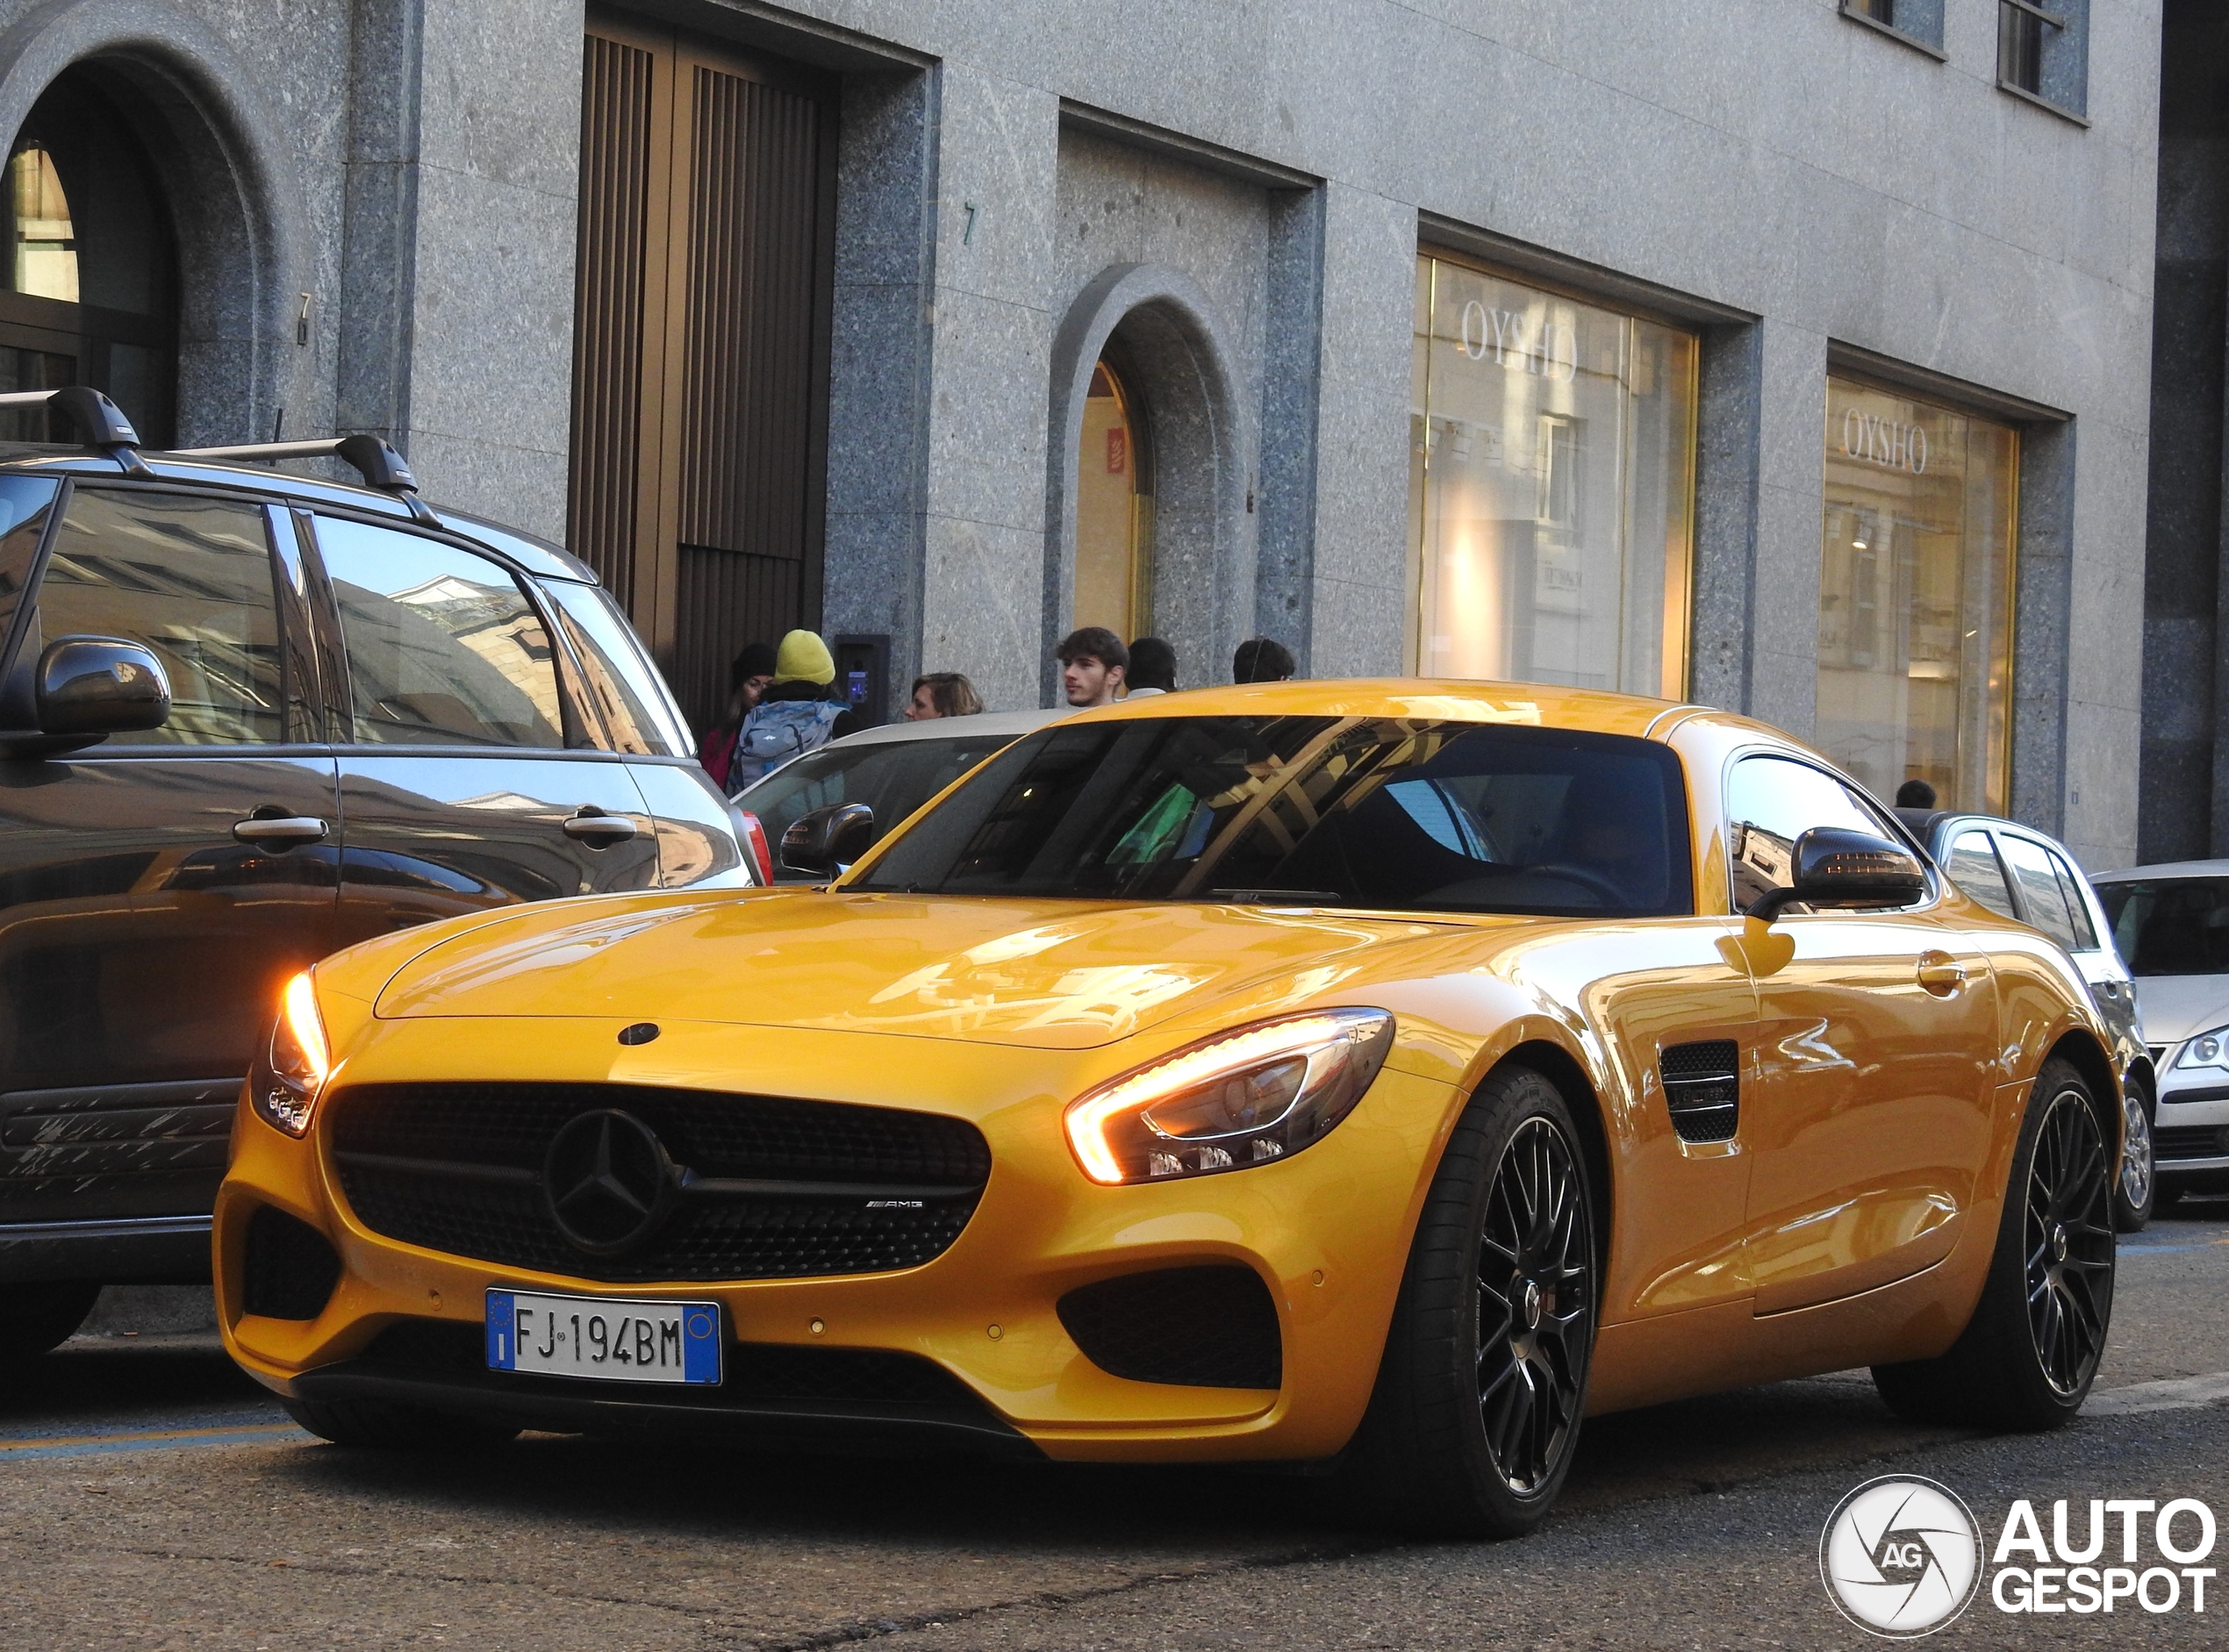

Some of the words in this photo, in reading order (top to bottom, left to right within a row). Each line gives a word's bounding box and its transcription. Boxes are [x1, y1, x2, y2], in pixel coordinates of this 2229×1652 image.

[964, 201, 978, 246] 7
[301, 292, 312, 318] 7
[1462, 300, 1578, 383] OYSHO
[1844, 408, 1927, 475] OYSHO
